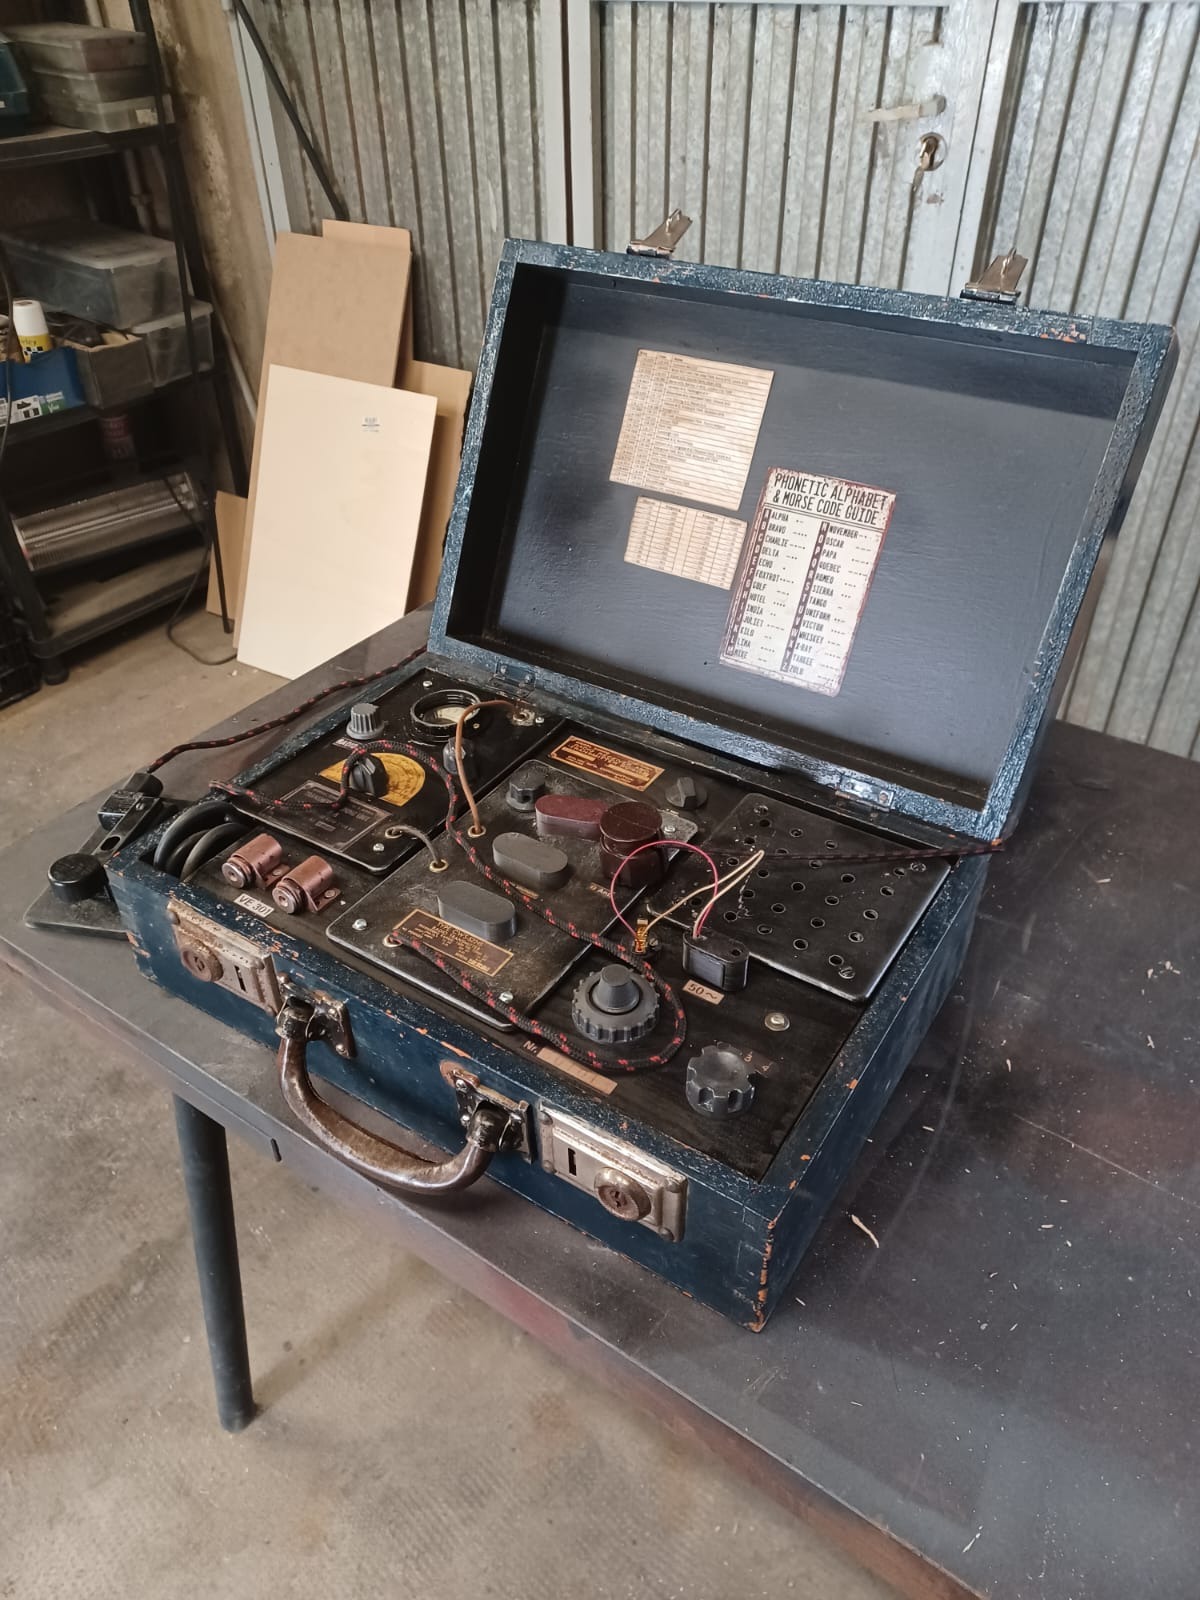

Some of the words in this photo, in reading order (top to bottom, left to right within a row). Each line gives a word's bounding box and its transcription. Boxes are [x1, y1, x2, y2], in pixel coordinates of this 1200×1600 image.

[774, 473, 829, 497] PHONETIC
[831, 485, 887, 510] ALPHABET
[773, 491, 780, 502] &
[782, 492, 814, 510] MORSE
[816, 500, 843, 516] CODE
[845, 506, 879, 524] GUIDE
[771, 512, 789, 522] ALPHA
[768, 523, 786, 534] BRAVO
[829, 525, 858, 538] NOVEMBER
[765, 535, 788, 547] CHARLIE
[825, 537, 844, 548] OSCAR
[762, 547, 779, 557] DELTA
[822, 549, 837, 559] PAPA
[759, 558, 773, 568] ECHO
[818, 561, 841, 572] QUEBEC
[755, 570, 779, 582] FOXTROT
[815, 573, 834, 583] ROMEO
[752, 581, 766, 591] GOLF
[812, 584, 834, 596] SIERRA
[749, 593, 766, 603] HOTEL
[809, 596, 827, 607] TANGO
[746, 604, 763, 614] INDIA
[805, 608, 831, 620] UNIFORM
[802, 619, 824, 631] VICTOR
[737, 638, 751, 647] LIMA
[799, 631, 824, 643] WHISKEY
[240, 896, 252, 906] VE
[252, 904, 271, 914] 301
[522, 1040, 537, 1053] Nr.
